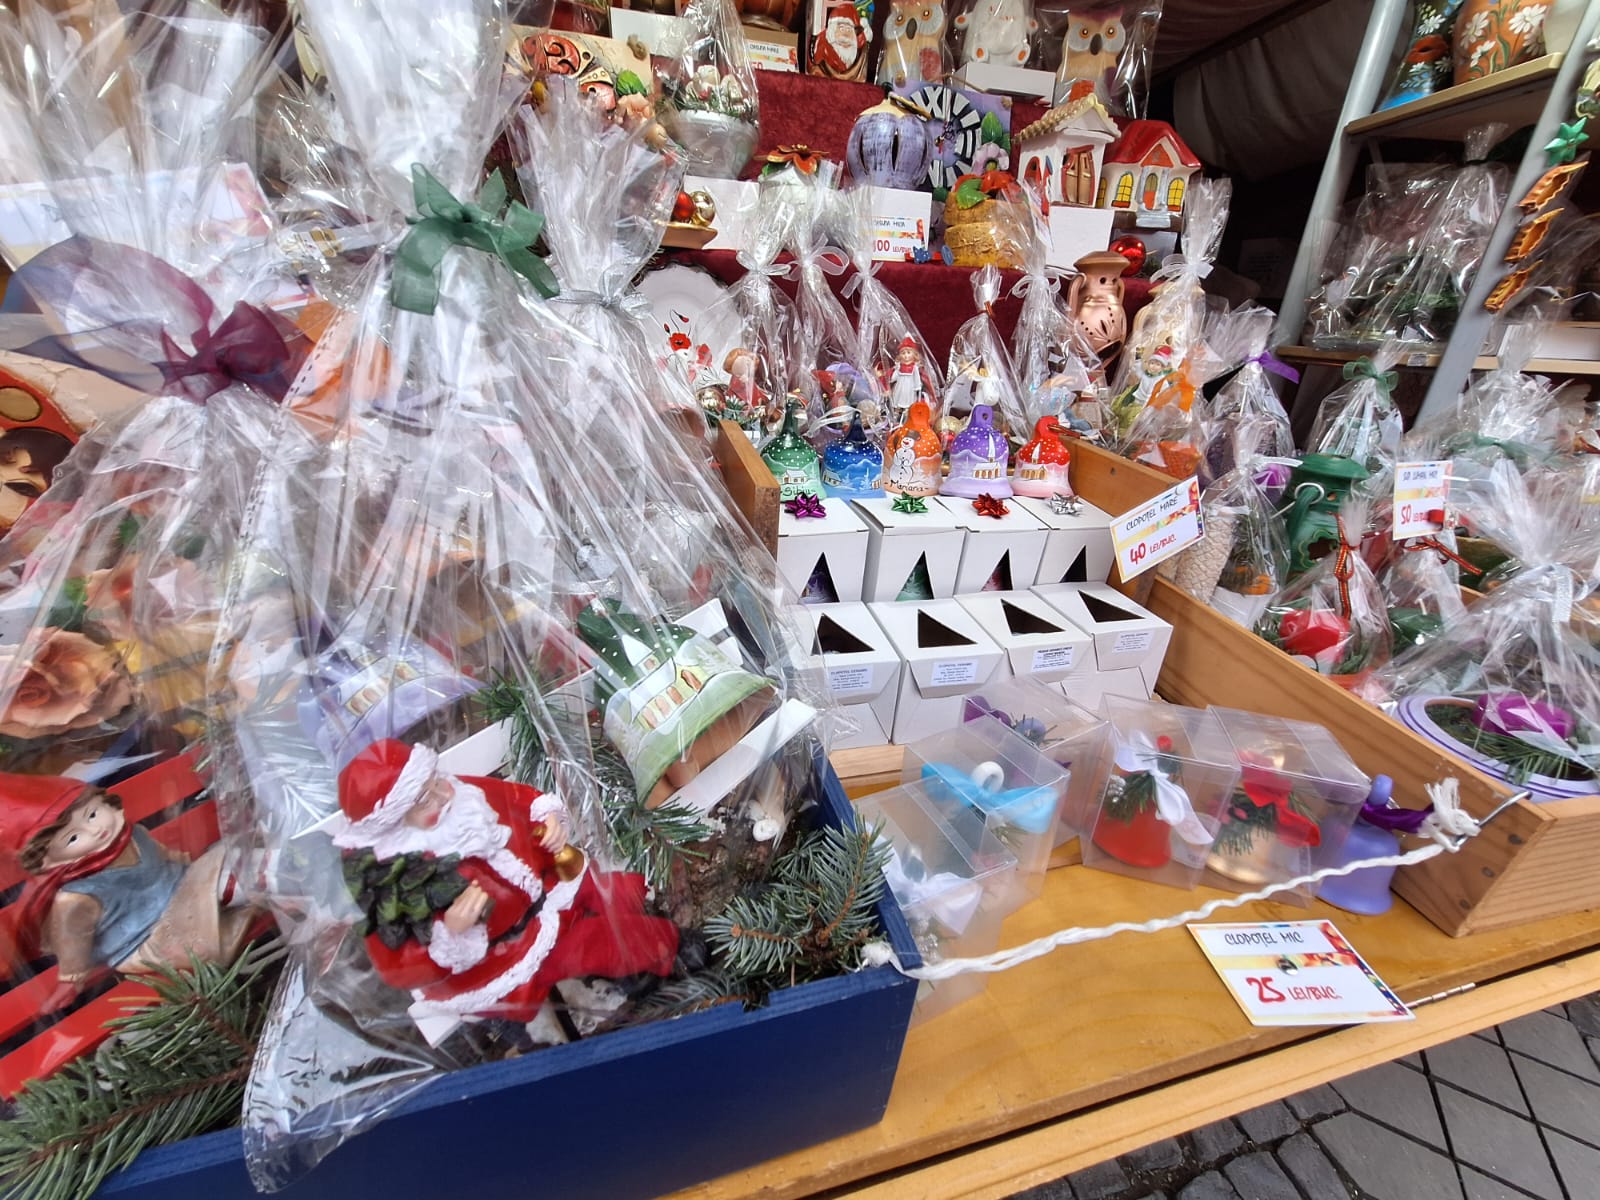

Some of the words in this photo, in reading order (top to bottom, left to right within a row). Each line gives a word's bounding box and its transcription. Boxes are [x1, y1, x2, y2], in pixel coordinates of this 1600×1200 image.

[1129, 542, 1147, 565] 40
[1280, 931, 1304, 944] MIC
[1245, 976, 1286, 1003] 25
